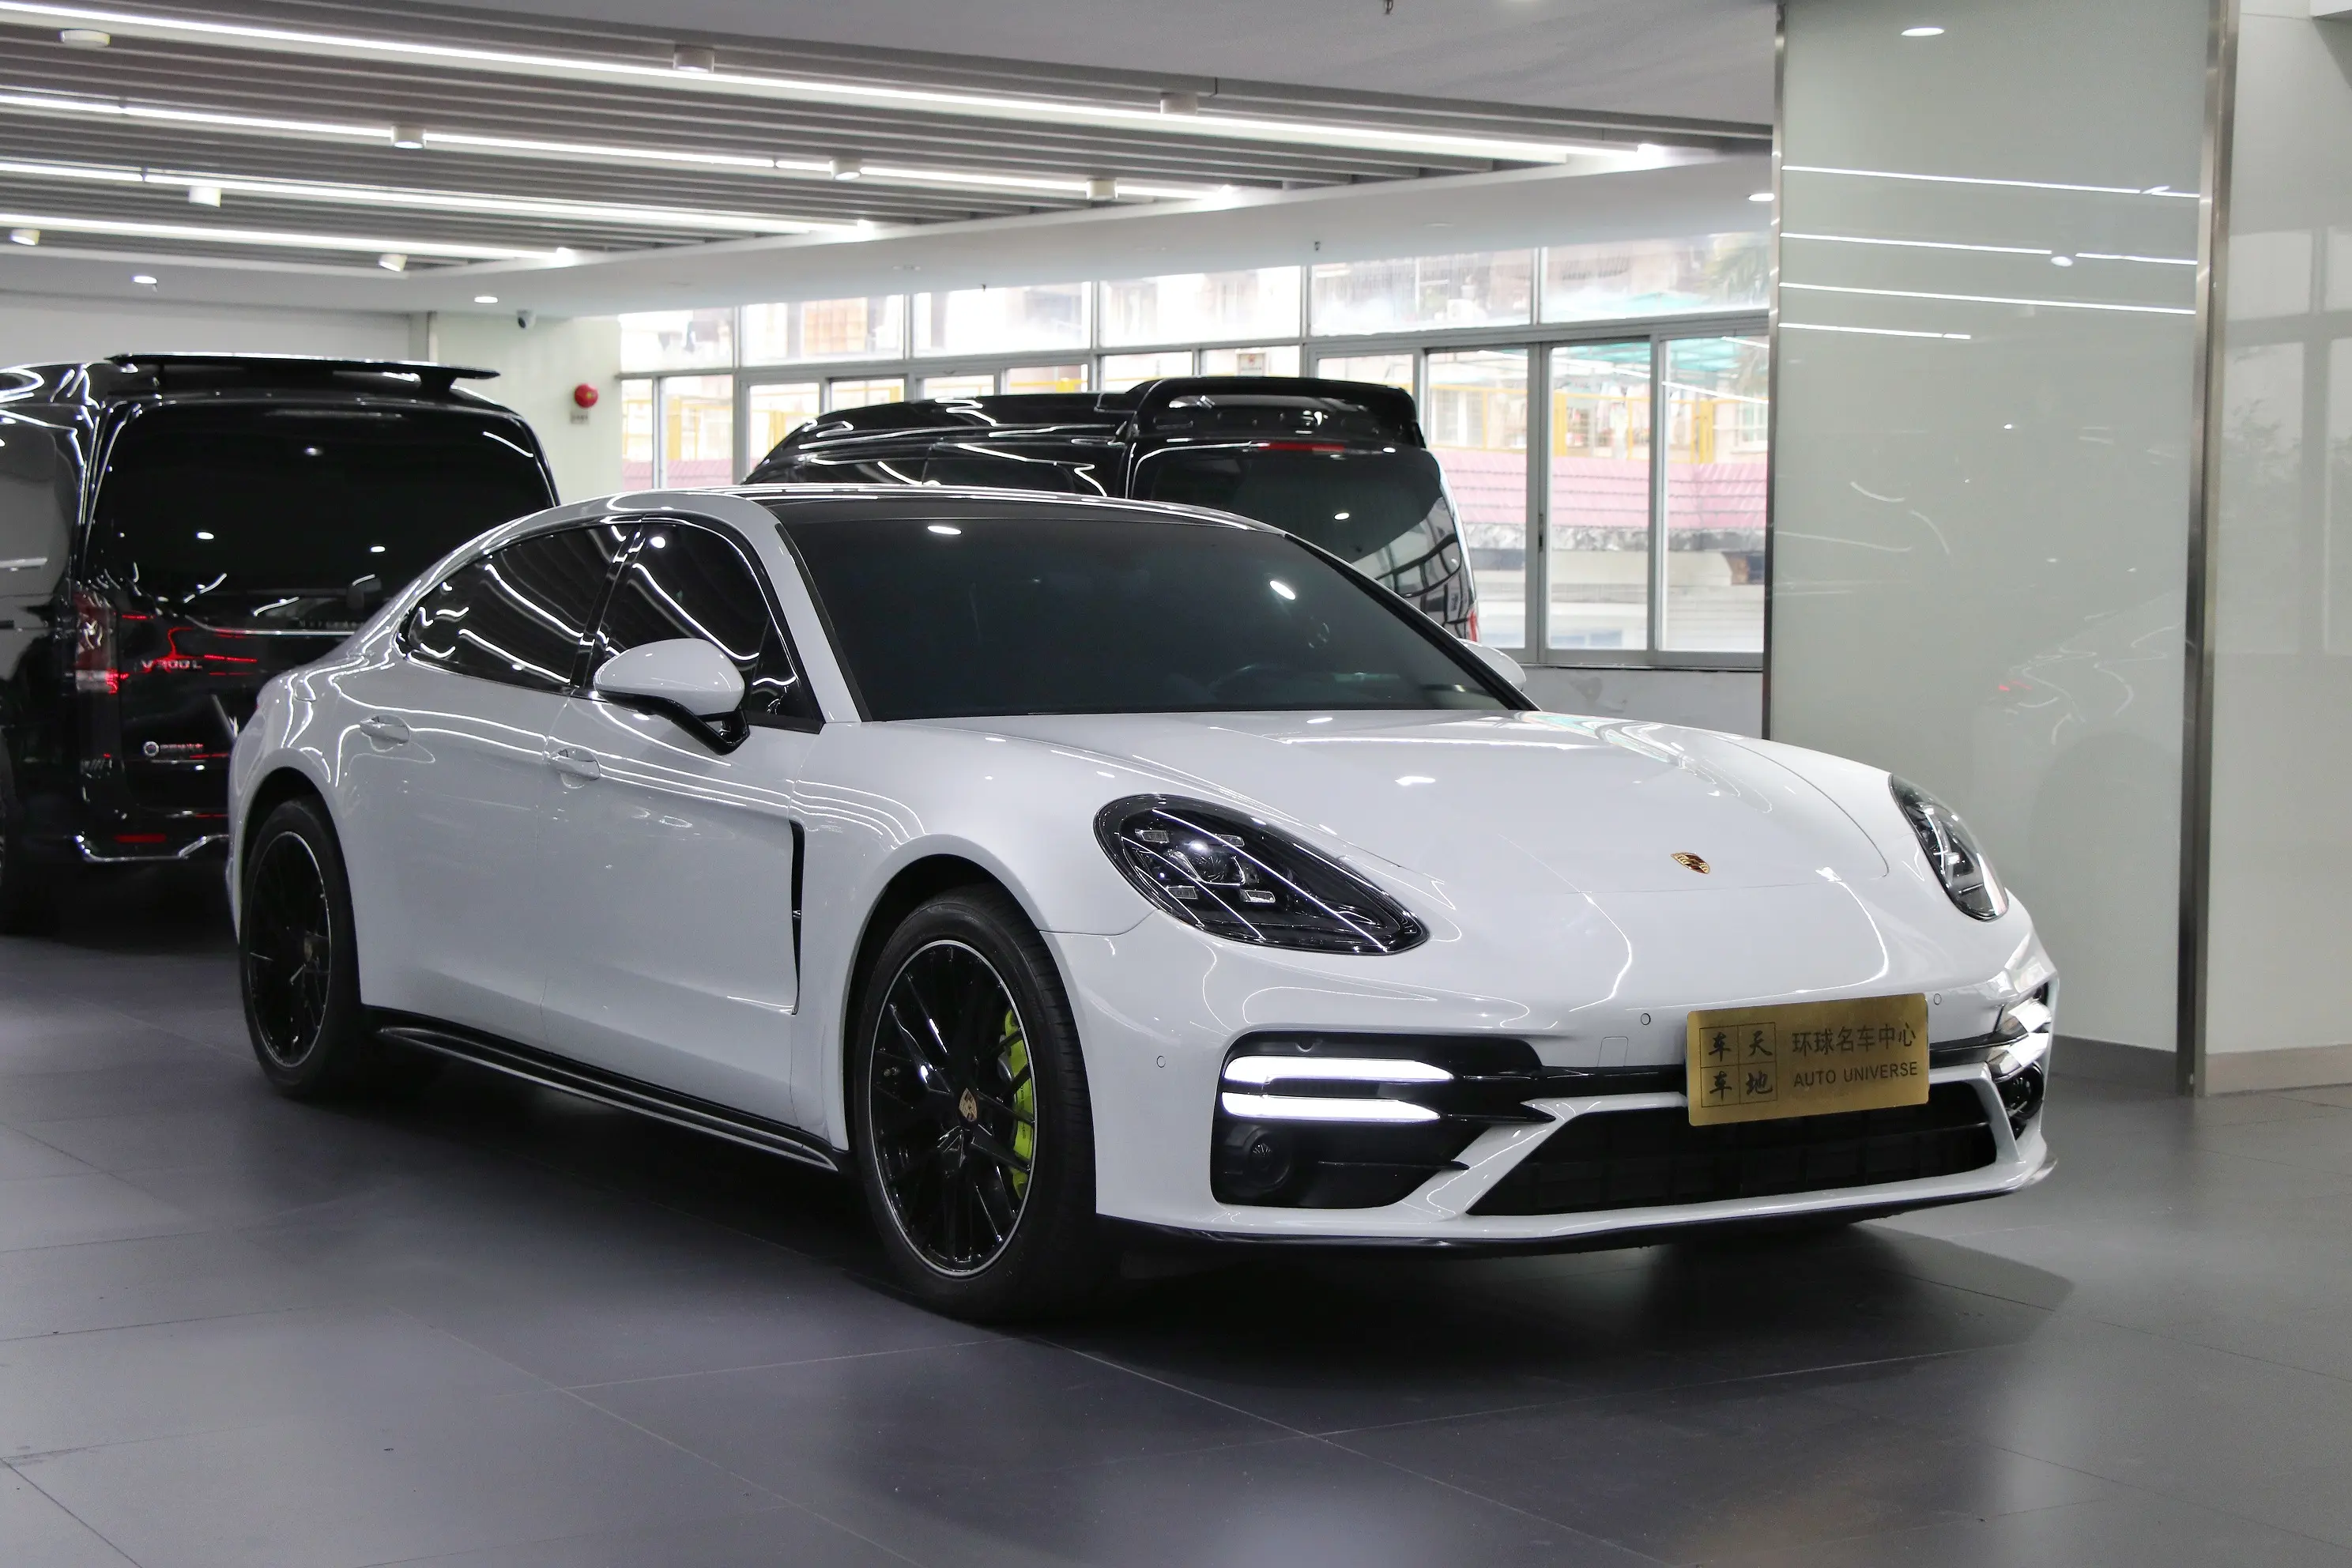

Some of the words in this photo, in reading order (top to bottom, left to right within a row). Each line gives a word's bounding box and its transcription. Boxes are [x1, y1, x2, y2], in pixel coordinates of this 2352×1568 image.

[1792, 1023, 1916, 1057] 环球名车中心
[1793, 1069, 1837, 1087] AUTO
[1843, 1061, 1918, 1083] UNIVERSE
